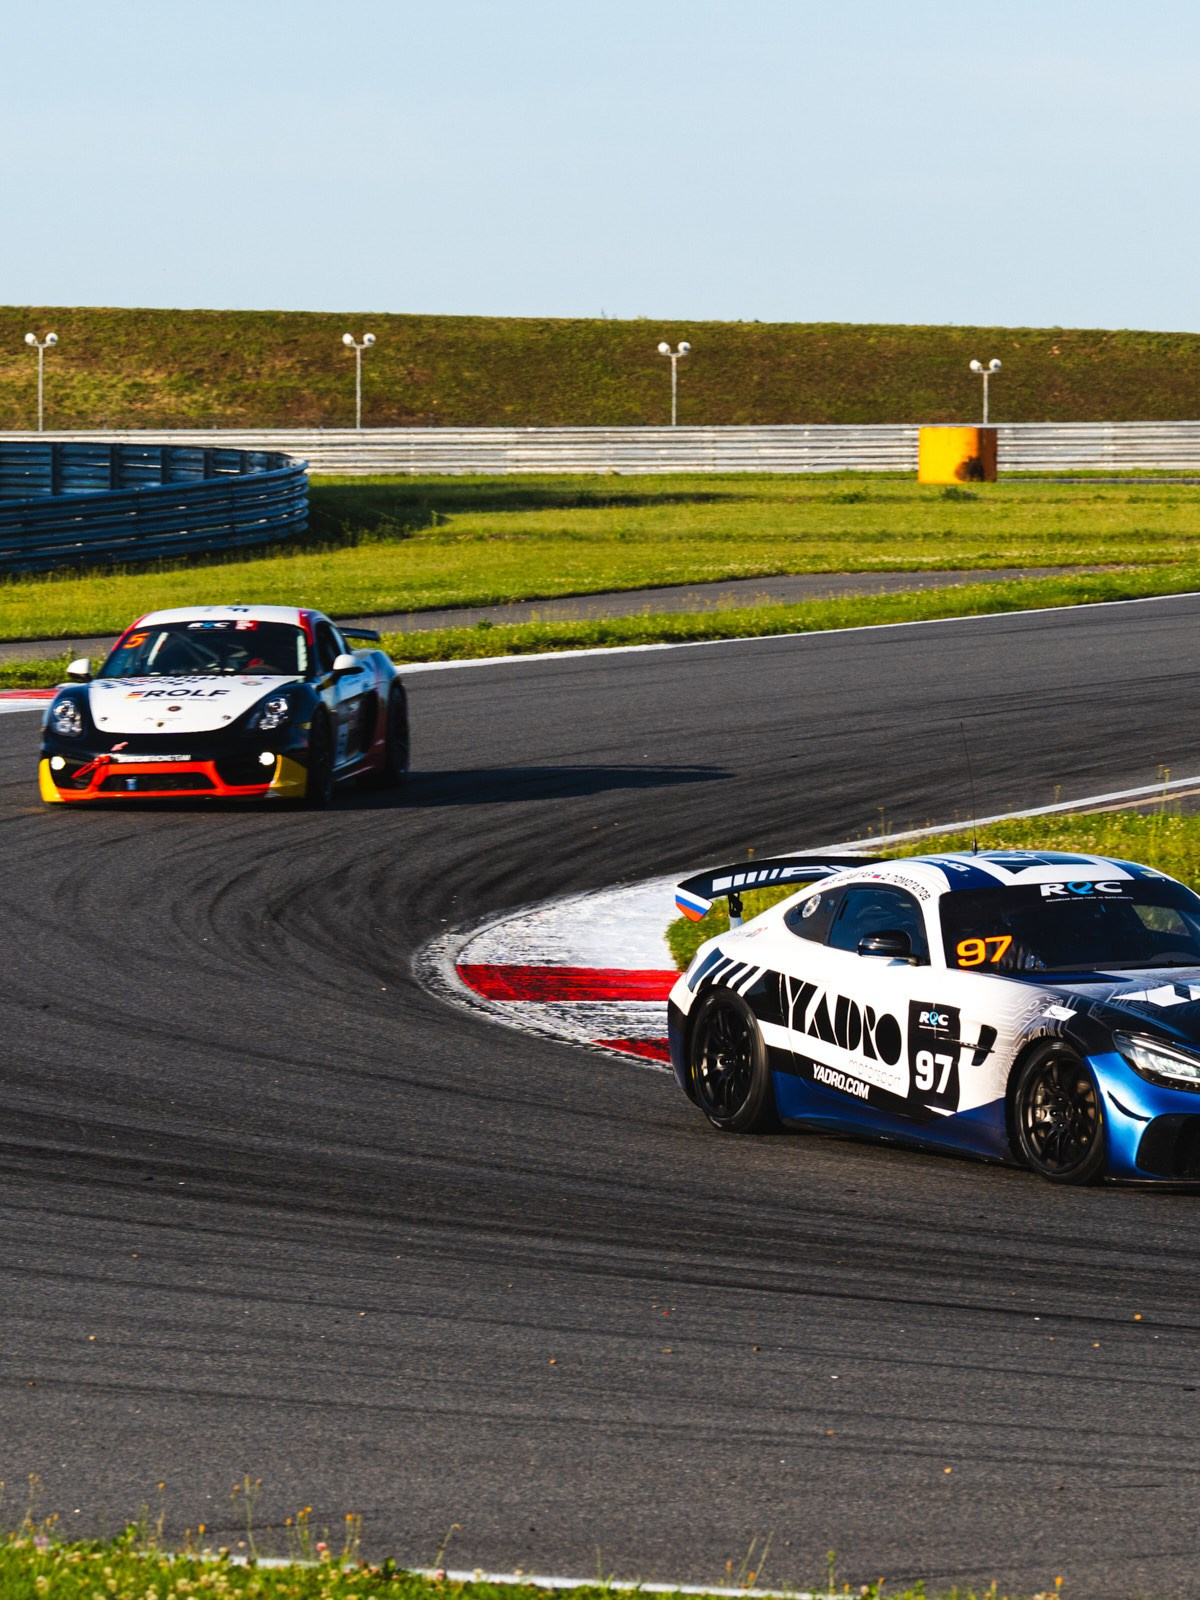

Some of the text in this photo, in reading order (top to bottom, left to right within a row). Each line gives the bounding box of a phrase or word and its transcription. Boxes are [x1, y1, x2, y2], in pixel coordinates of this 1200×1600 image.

[122, 632, 150, 649] 5
[143, 688, 232, 699] ROLF
[956, 935, 1013, 967] 97
[788, 976, 902, 1066] YADRO
[812, 1063, 870, 1100] YADRO.COM
[915, 1049, 954, 1094] 97
